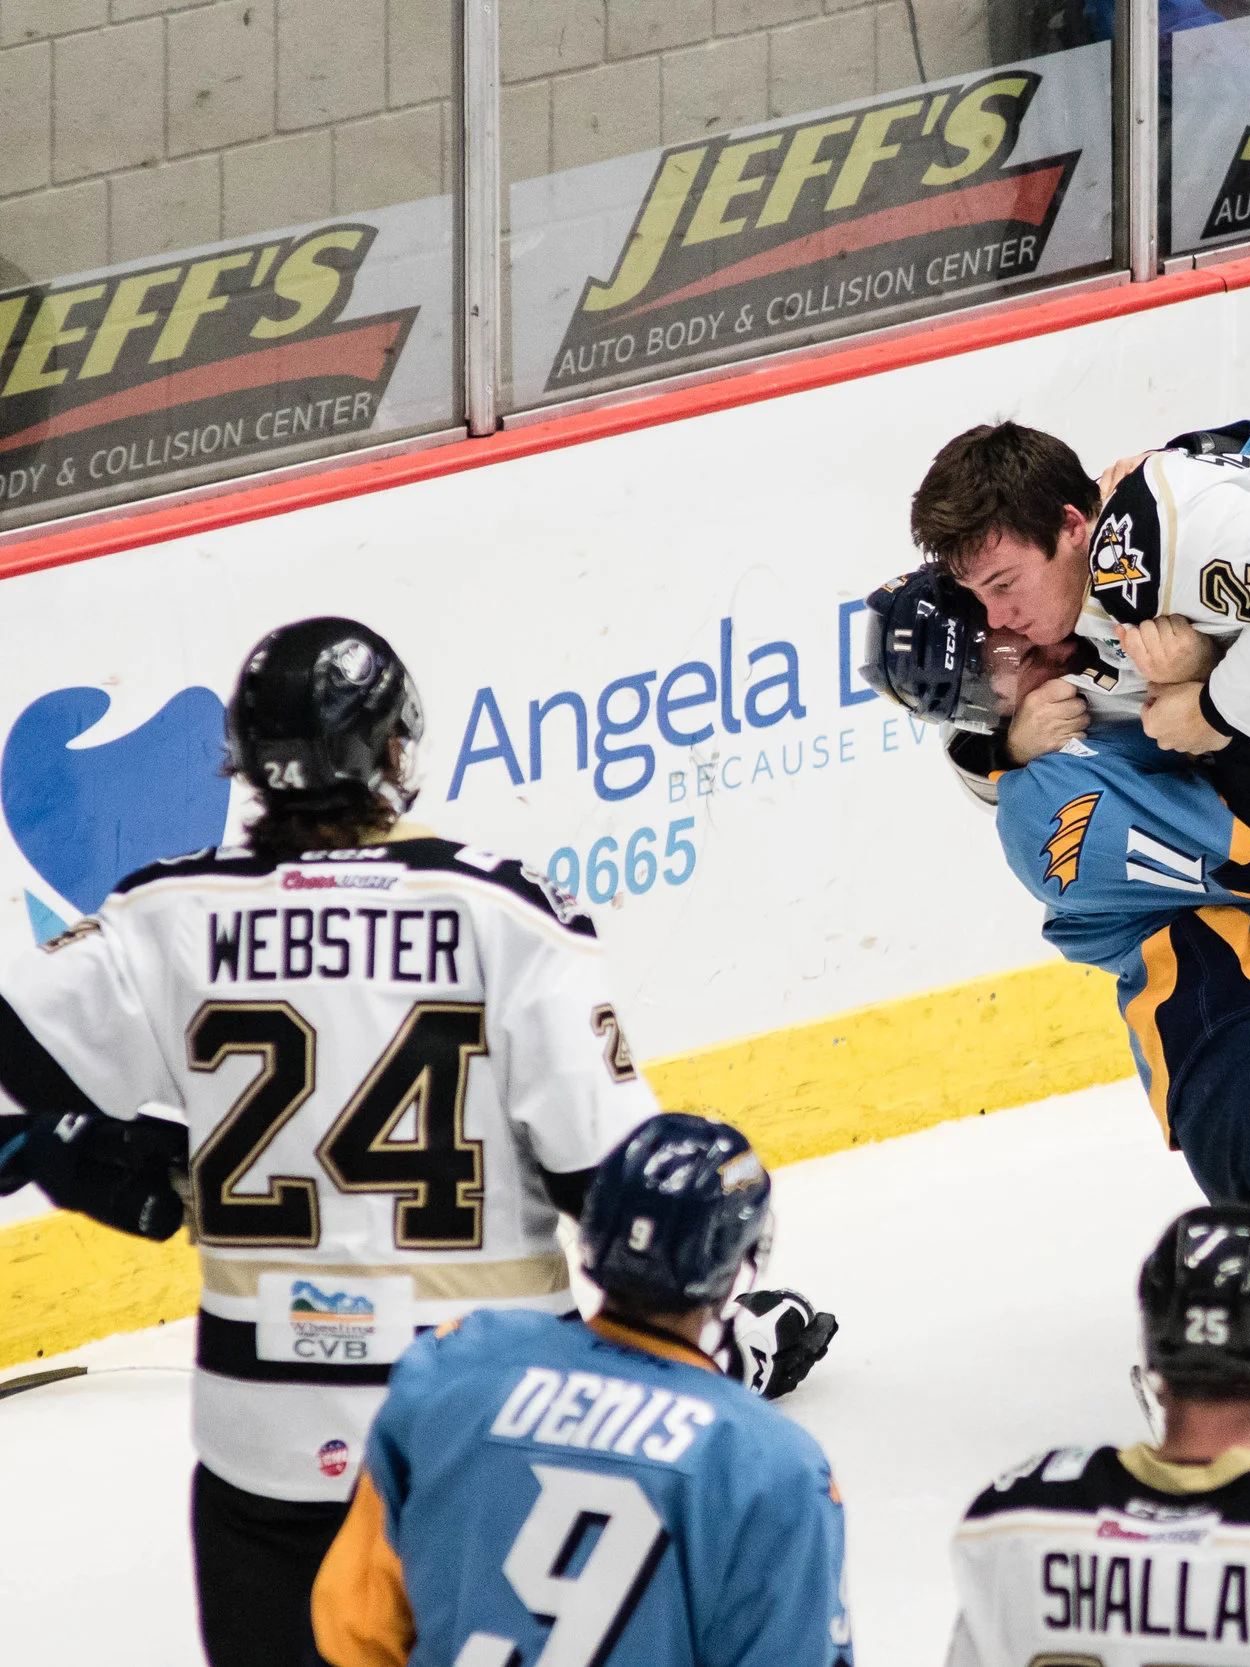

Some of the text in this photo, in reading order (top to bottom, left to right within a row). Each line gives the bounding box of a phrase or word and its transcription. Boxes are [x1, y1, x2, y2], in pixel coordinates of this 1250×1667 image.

[582, 78, 1028, 312] JEFF'S
[557, 235, 1036, 378] AUTO BODY & COLLISION CENTER
[56, 457, 76, 487] &
[90, 418, 243, 478] COLLISION
[256, 391, 373, 440] CENTER
[944, 618, 957, 670] CCM
[448, 617, 806, 801] Angela
[265, 760, 301, 788] 24
[669, 728, 855, 803] BECAUSE
[547, 816, 696, 905] 9665
[209, 907, 460, 983] WEBSTER
[185, 1000, 488, 1249] 24
[629, 1216, 653, 1251] 9
[293, 1339, 367, 1359] CVB
[1185, 1306, 1230, 1346] 25
[490, 1366, 720, 1464] DENIS
[453, 1464, 670, 1667] 9
[1043, 1552, 1250, 1643] SHALLA
